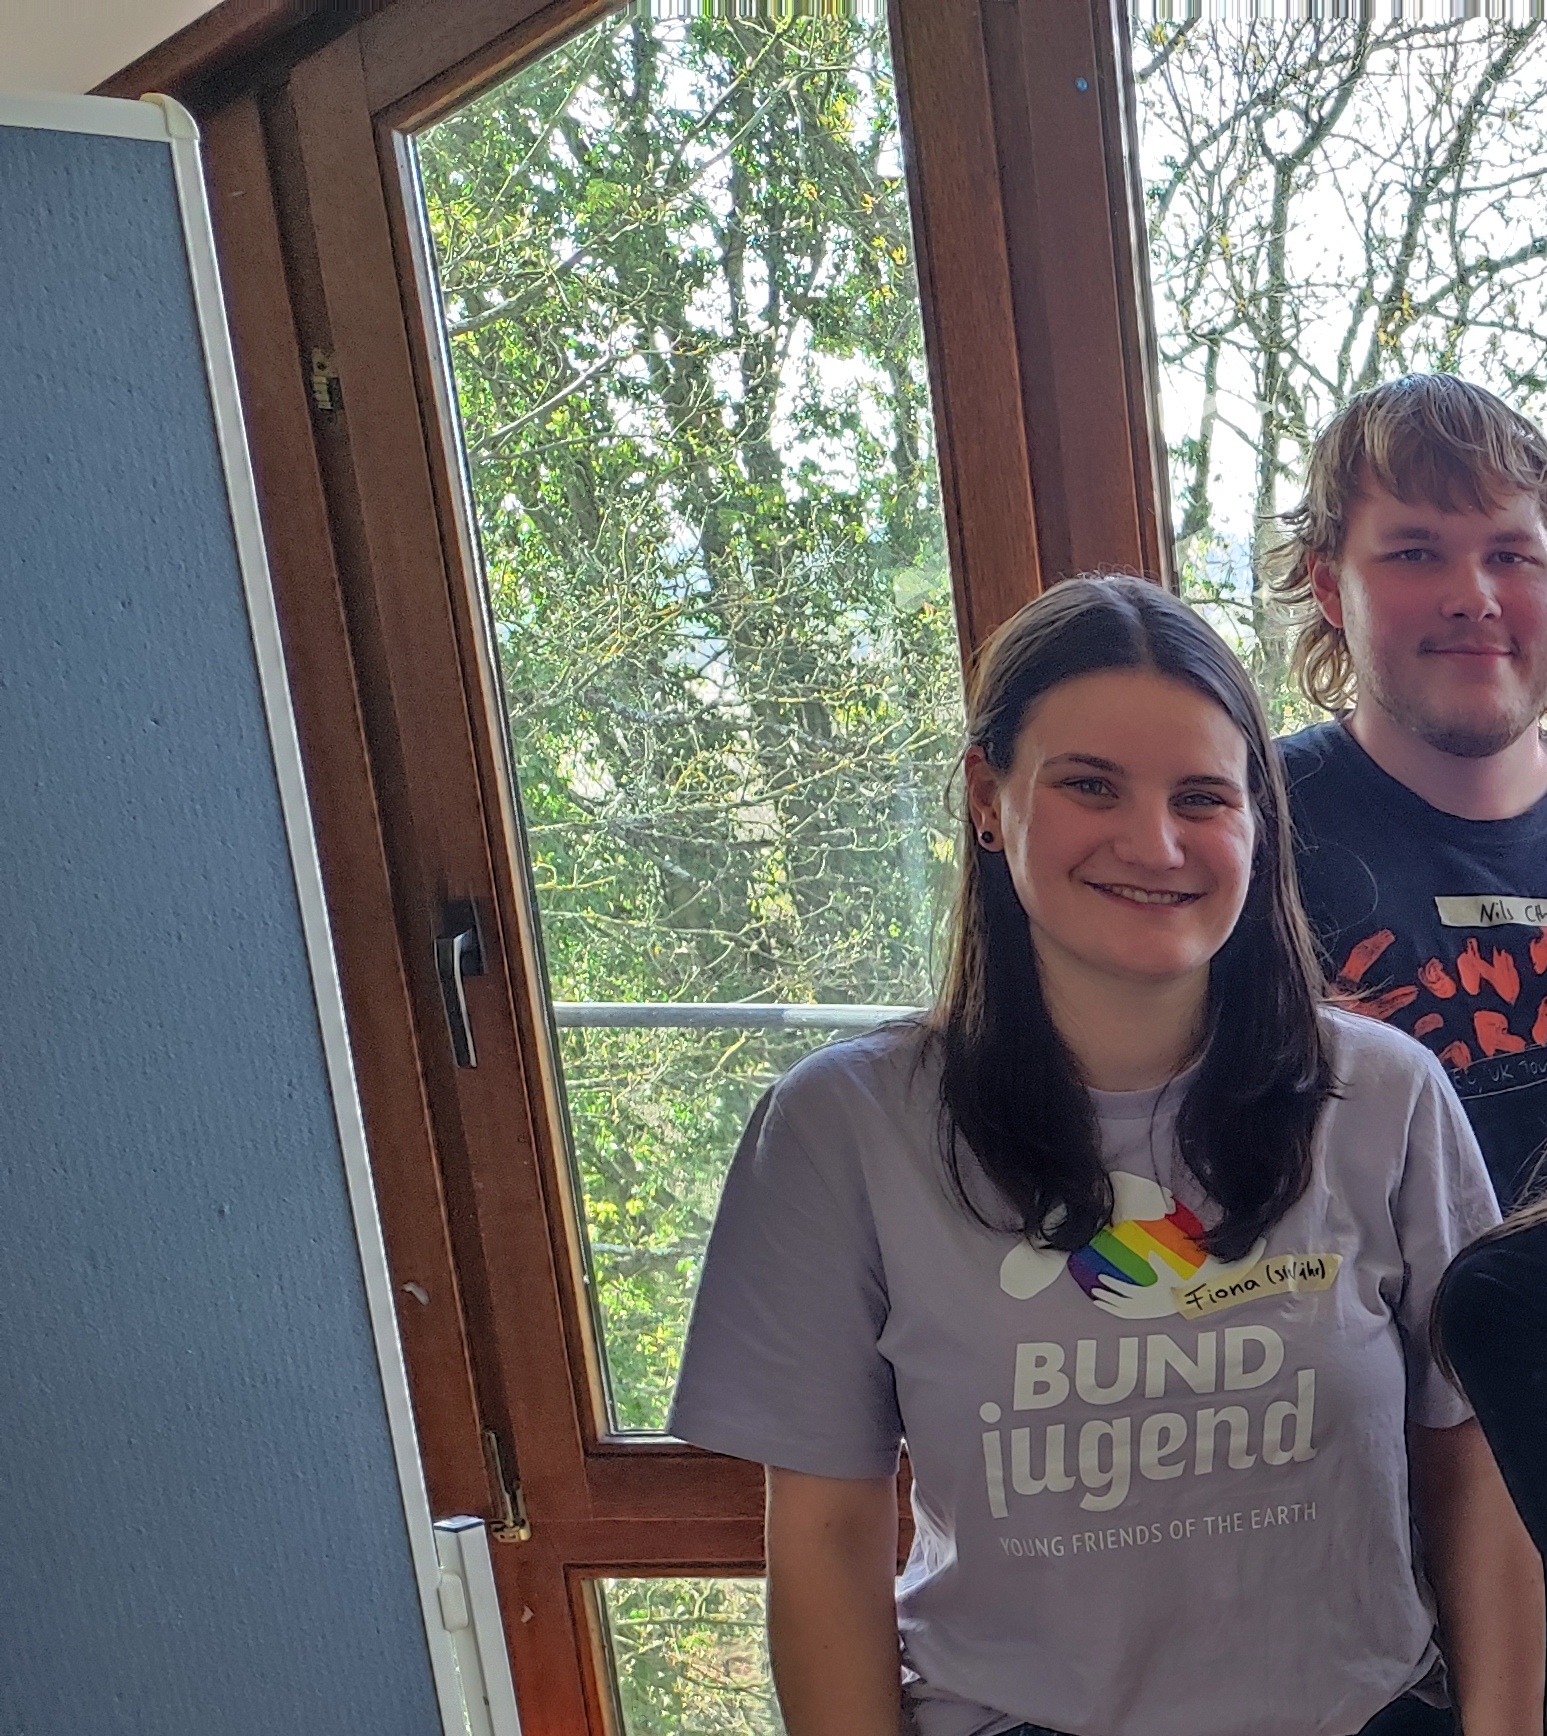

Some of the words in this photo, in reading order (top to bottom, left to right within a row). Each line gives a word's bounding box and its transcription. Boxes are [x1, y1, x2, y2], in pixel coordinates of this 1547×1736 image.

[1480, 901, 1514, 923] Nils
[1184, 1282, 1261, 1311] Fiona
[1012, 1325, 1285, 1411] BUND
[978, 1368, 1318, 1519] jugend
[1000, 1536, 1065, 1558] YOUNG
[1072, 1523, 1162, 1554] FRIENDS
[1169, 1518, 1197, 1540] OF
[1203, 1512, 1244, 1536] THE
[1250, 1502, 1317, 1530] EARTH
